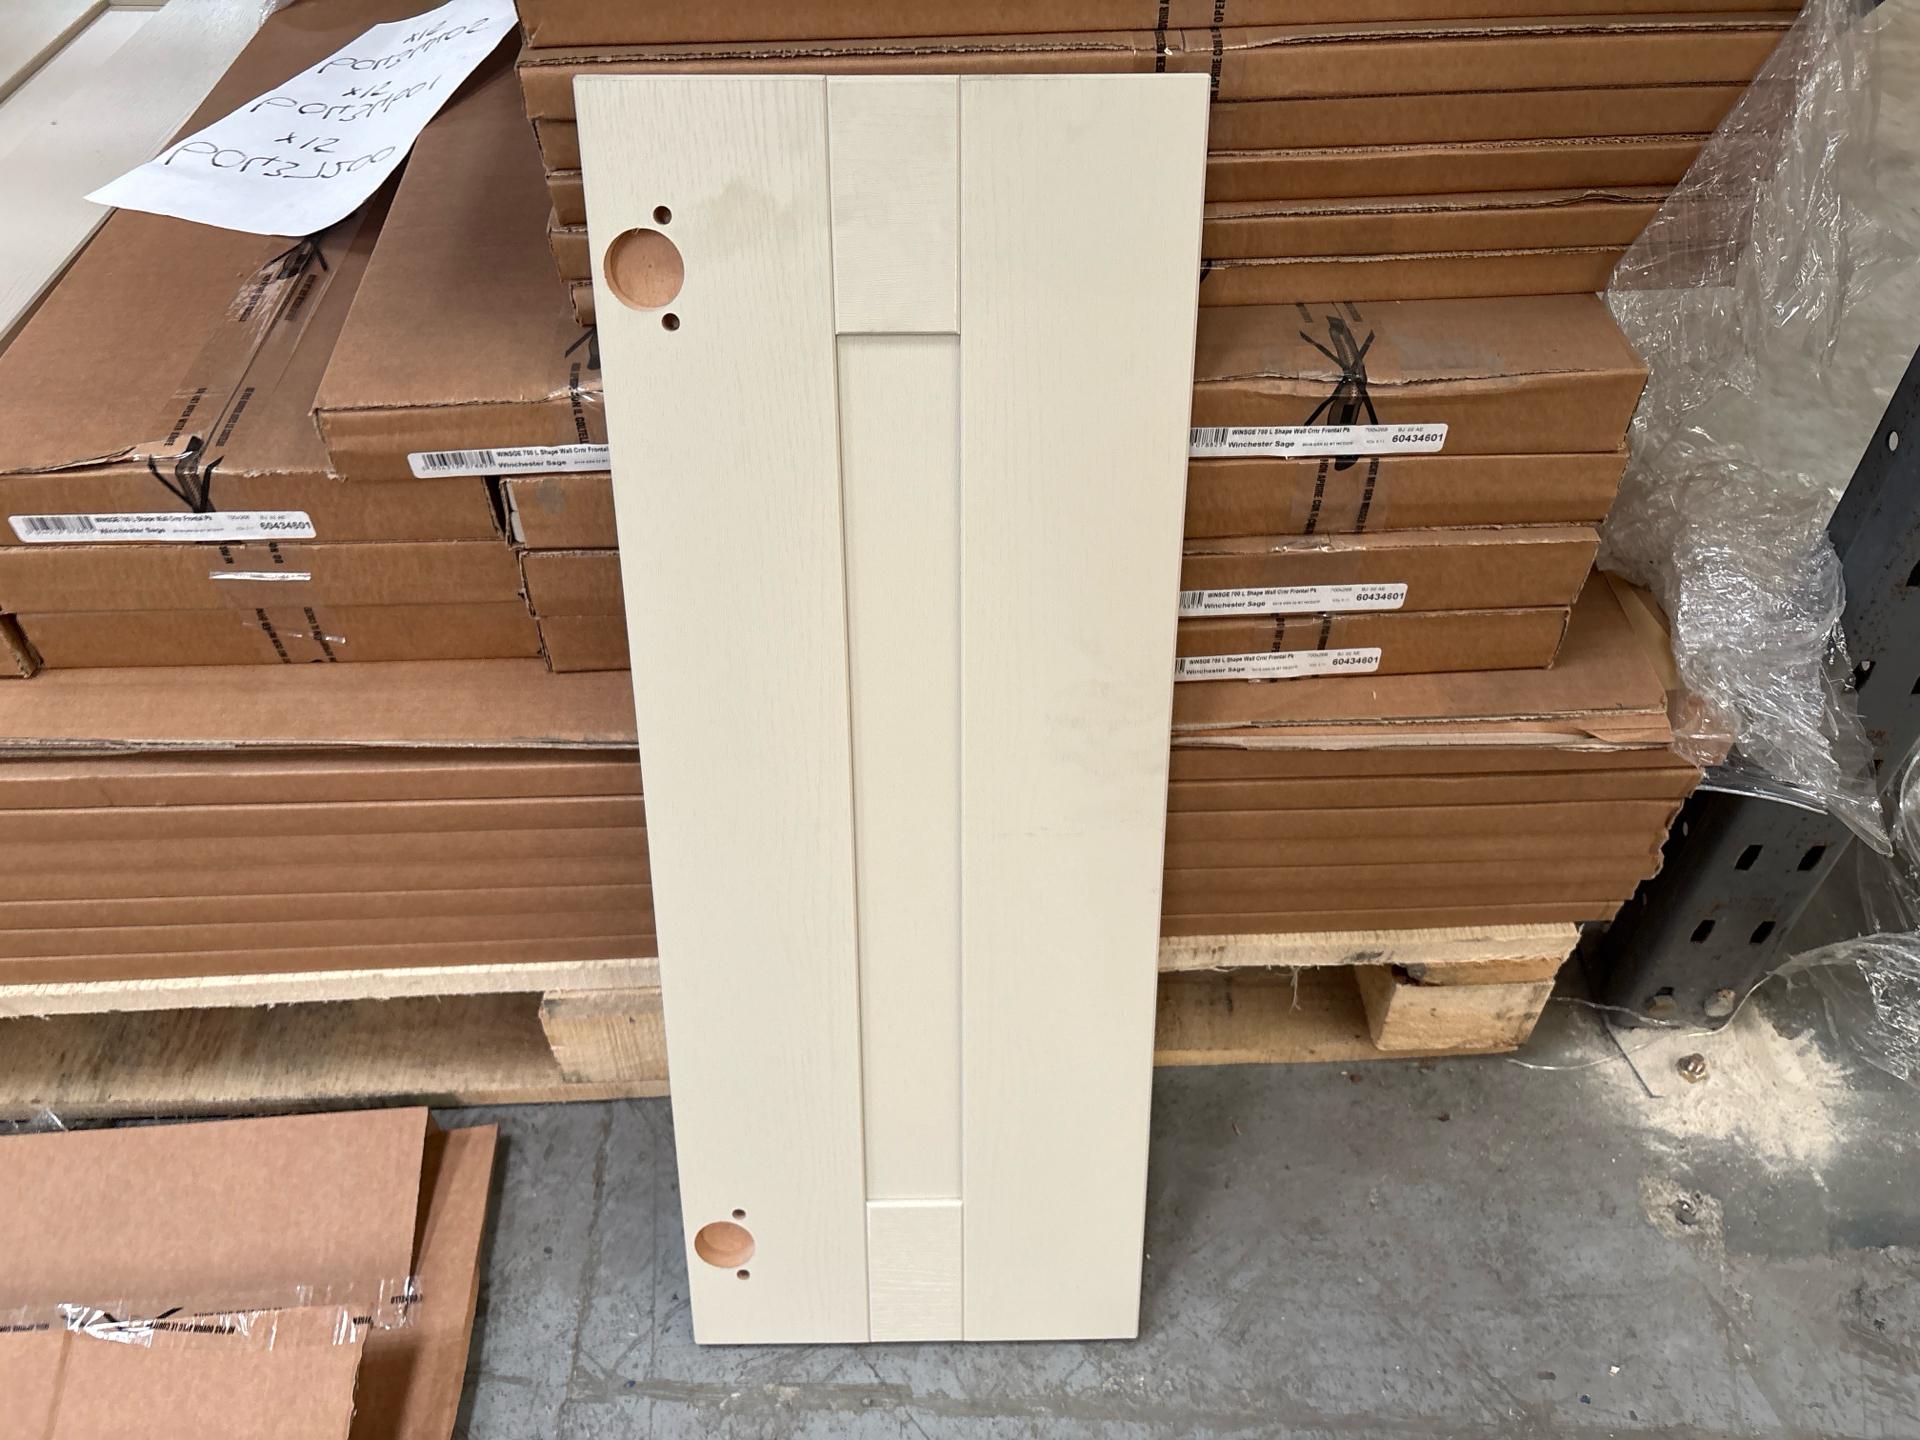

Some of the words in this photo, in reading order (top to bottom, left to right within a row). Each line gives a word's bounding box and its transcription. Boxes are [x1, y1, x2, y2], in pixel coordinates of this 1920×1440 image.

[1211, 58, 1222, 89] APRIRE
[273, 131, 341, 154] x12
[1274, 428, 1292, 436] Shape
[1391, 433, 1444, 443] 60434601
[1274, 440, 1295, 448] Sage
[540, 448, 559, 456] Shape
[259, 521, 311, 530] 60434601
[1356, 592, 1404, 601] 60434601
[1204, 601, 1245, 609] Winchester
[1332, 656, 1378, 665] 60434601
[214, 1325, 226, 1335] PAS
